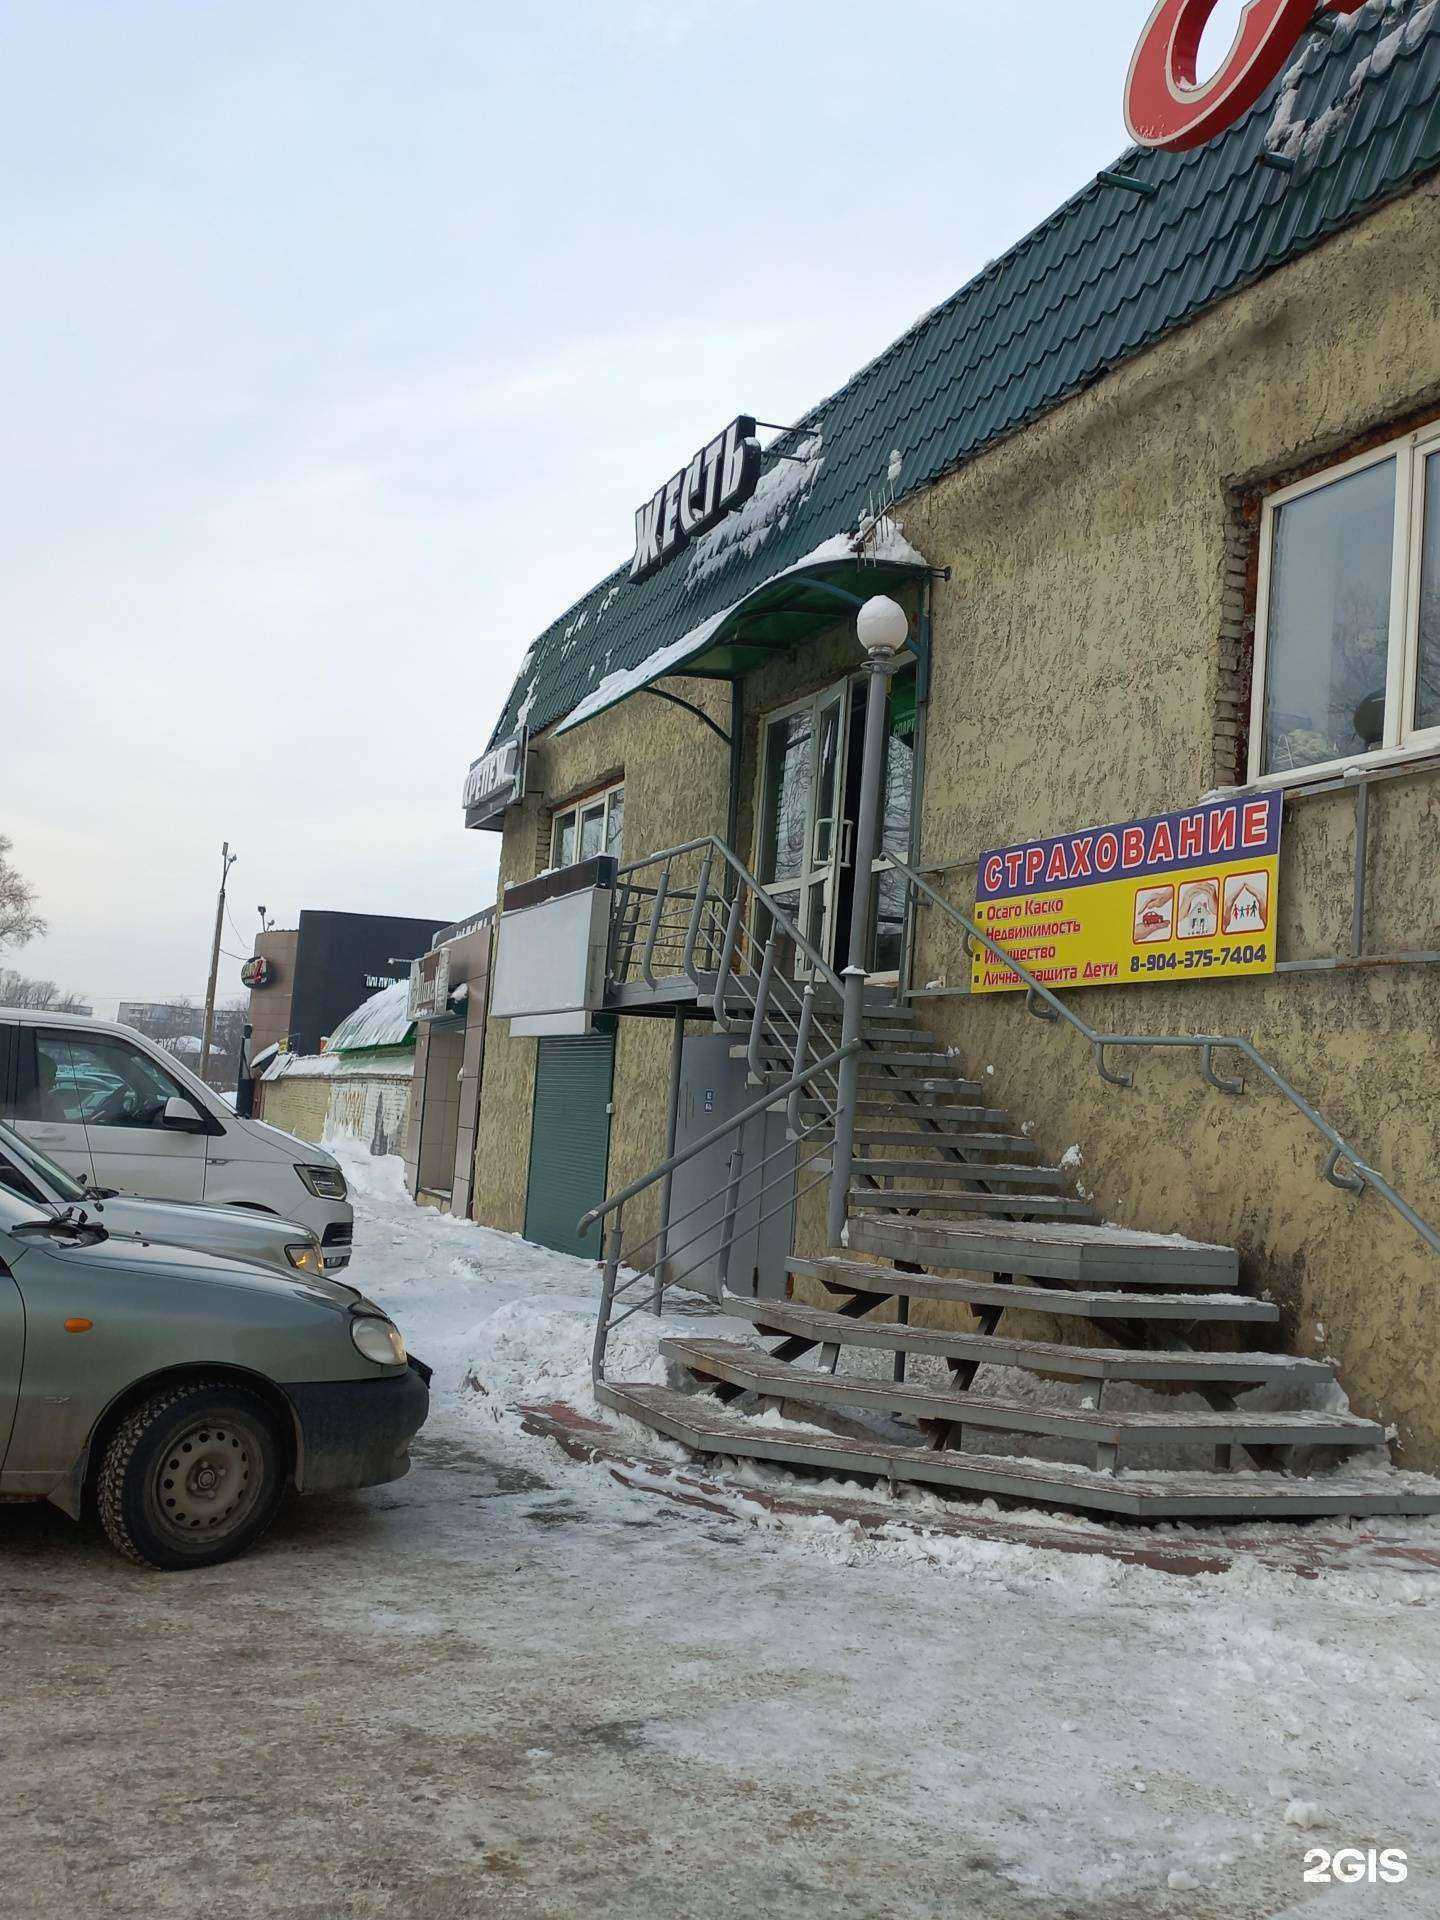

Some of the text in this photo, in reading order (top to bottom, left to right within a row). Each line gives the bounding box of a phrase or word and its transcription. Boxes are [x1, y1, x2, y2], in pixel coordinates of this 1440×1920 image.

[627, 415, 757, 580] ЖЕСТЬ
[984, 800, 1270, 892] СТРАХОВАНИЕ
[986, 898, 1064, 921] Осаго Каско
[985, 919, 1081, 942] Недвижимость
[984, 946, 1056, 965] Имщество
[1130, 944, 1267, 973] 8-904-375-7404
[1082, 961, 1119, 979] Дети
